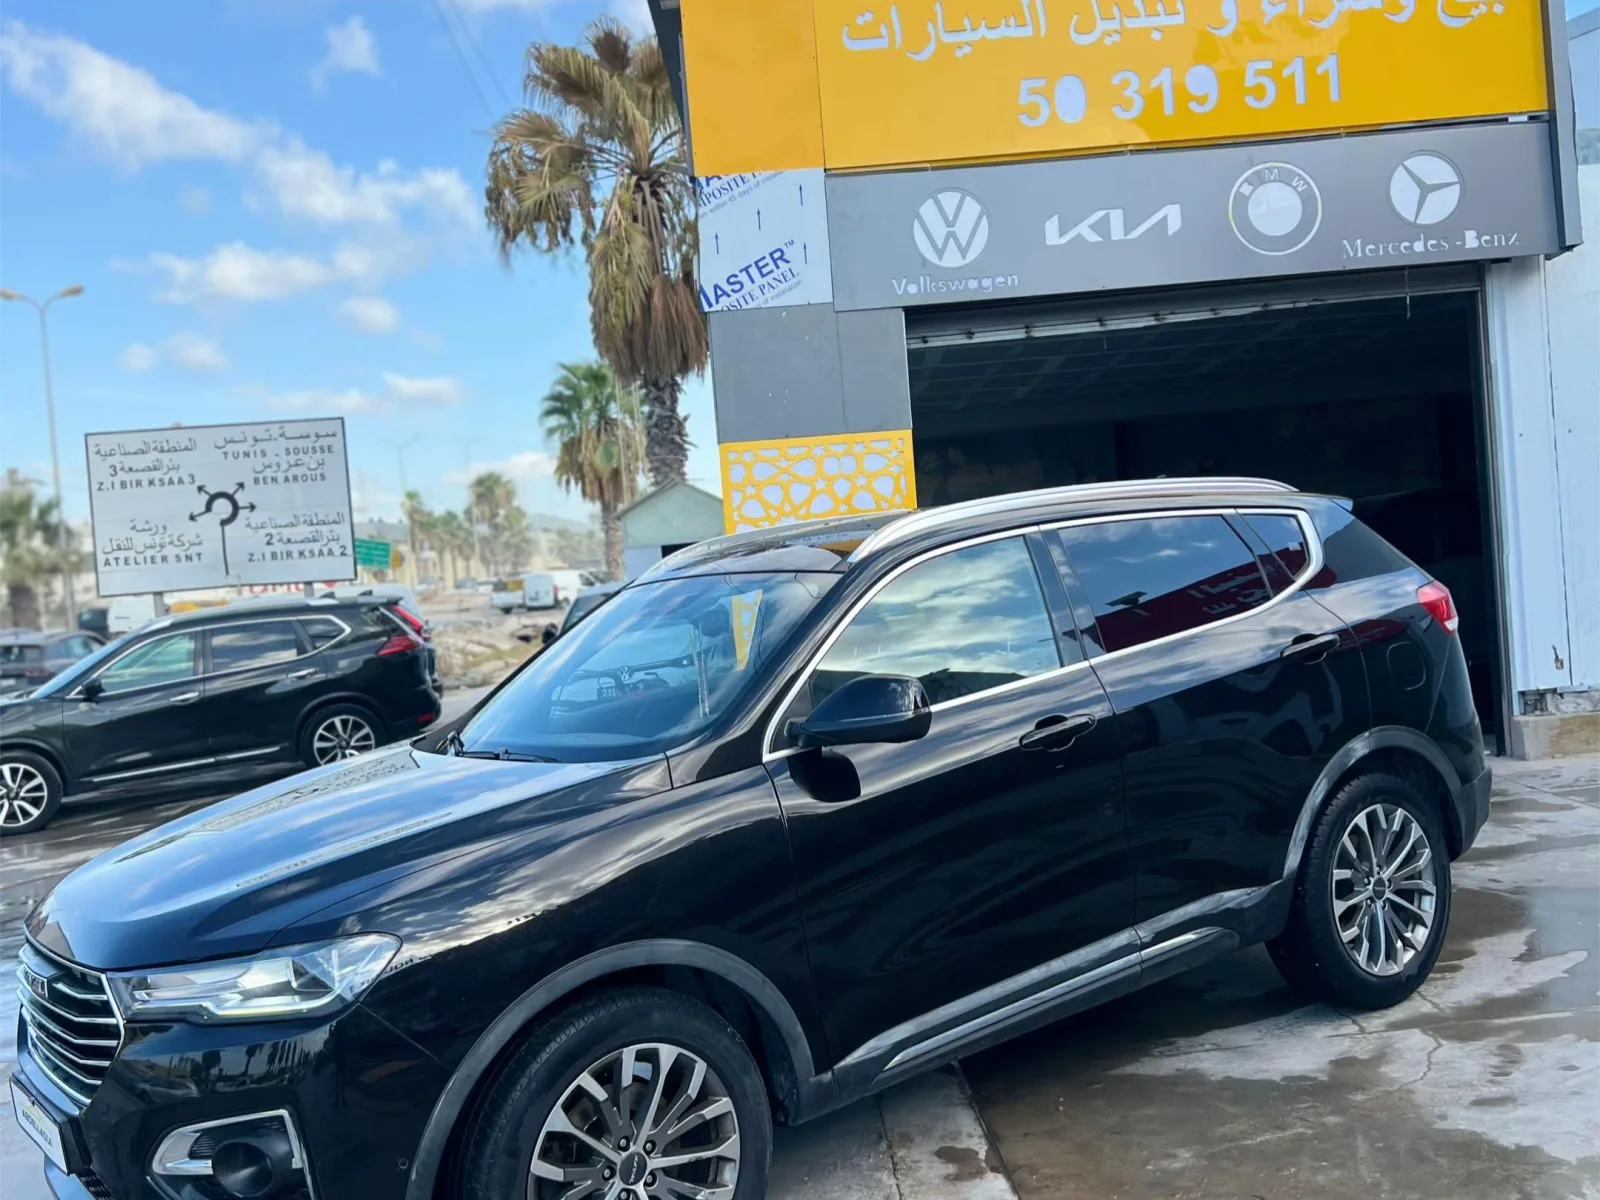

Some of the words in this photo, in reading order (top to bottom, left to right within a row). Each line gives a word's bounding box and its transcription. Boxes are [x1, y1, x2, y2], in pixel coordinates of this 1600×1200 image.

[841, 0, 1047, 61] السيارات
[1017, 74, 1088, 127] 50
[1111, 65, 1219, 120] 319
[1244, 53, 1341, 109] 511
[758, 268, 800, 296] PANEL
[892, 274, 1019, 295] Volkswagen
[214, 428, 273, 449] تونس
[278, 425, 337, 444] سوسة
[94, 440, 151, 461] الصناعية
[151, 437, 197, 454] المنطقة
[222, 449, 267, 460] TUNIS
[284, 444, 335, 456] SOUSSE
[109, 464, 118, 477] 3
[252, 457, 306, 474] عروس
[306, 455, 325, 471] بن
[97, 480, 115, 491] Z.I
[120, 478, 144, 489] BIR
[148, 477, 185, 487] KSAA
[188, 473, 196, 485] 3
[253, 475, 279, 485] BEN
[283, 473, 327, 483] AROUS
[129, 518, 167, 536] ورشة
[244, 513, 301, 533] الصناعية
[301, 511, 345, 526] المنطقة
[102, 536, 134, 555] للنقل
[134, 536, 167, 554] تونس
[167, 533, 204, 552] شركة
[265, 532, 274, 546] 2
[103, 555, 169, 567] ATELIER
[174, 552, 203, 563] SNT
[248, 552, 266, 562] Z.I
[270, 550, 294, 560] BIR
[298, 547, 335, 559] KSAA
[339, 545, 348, 557] 2
